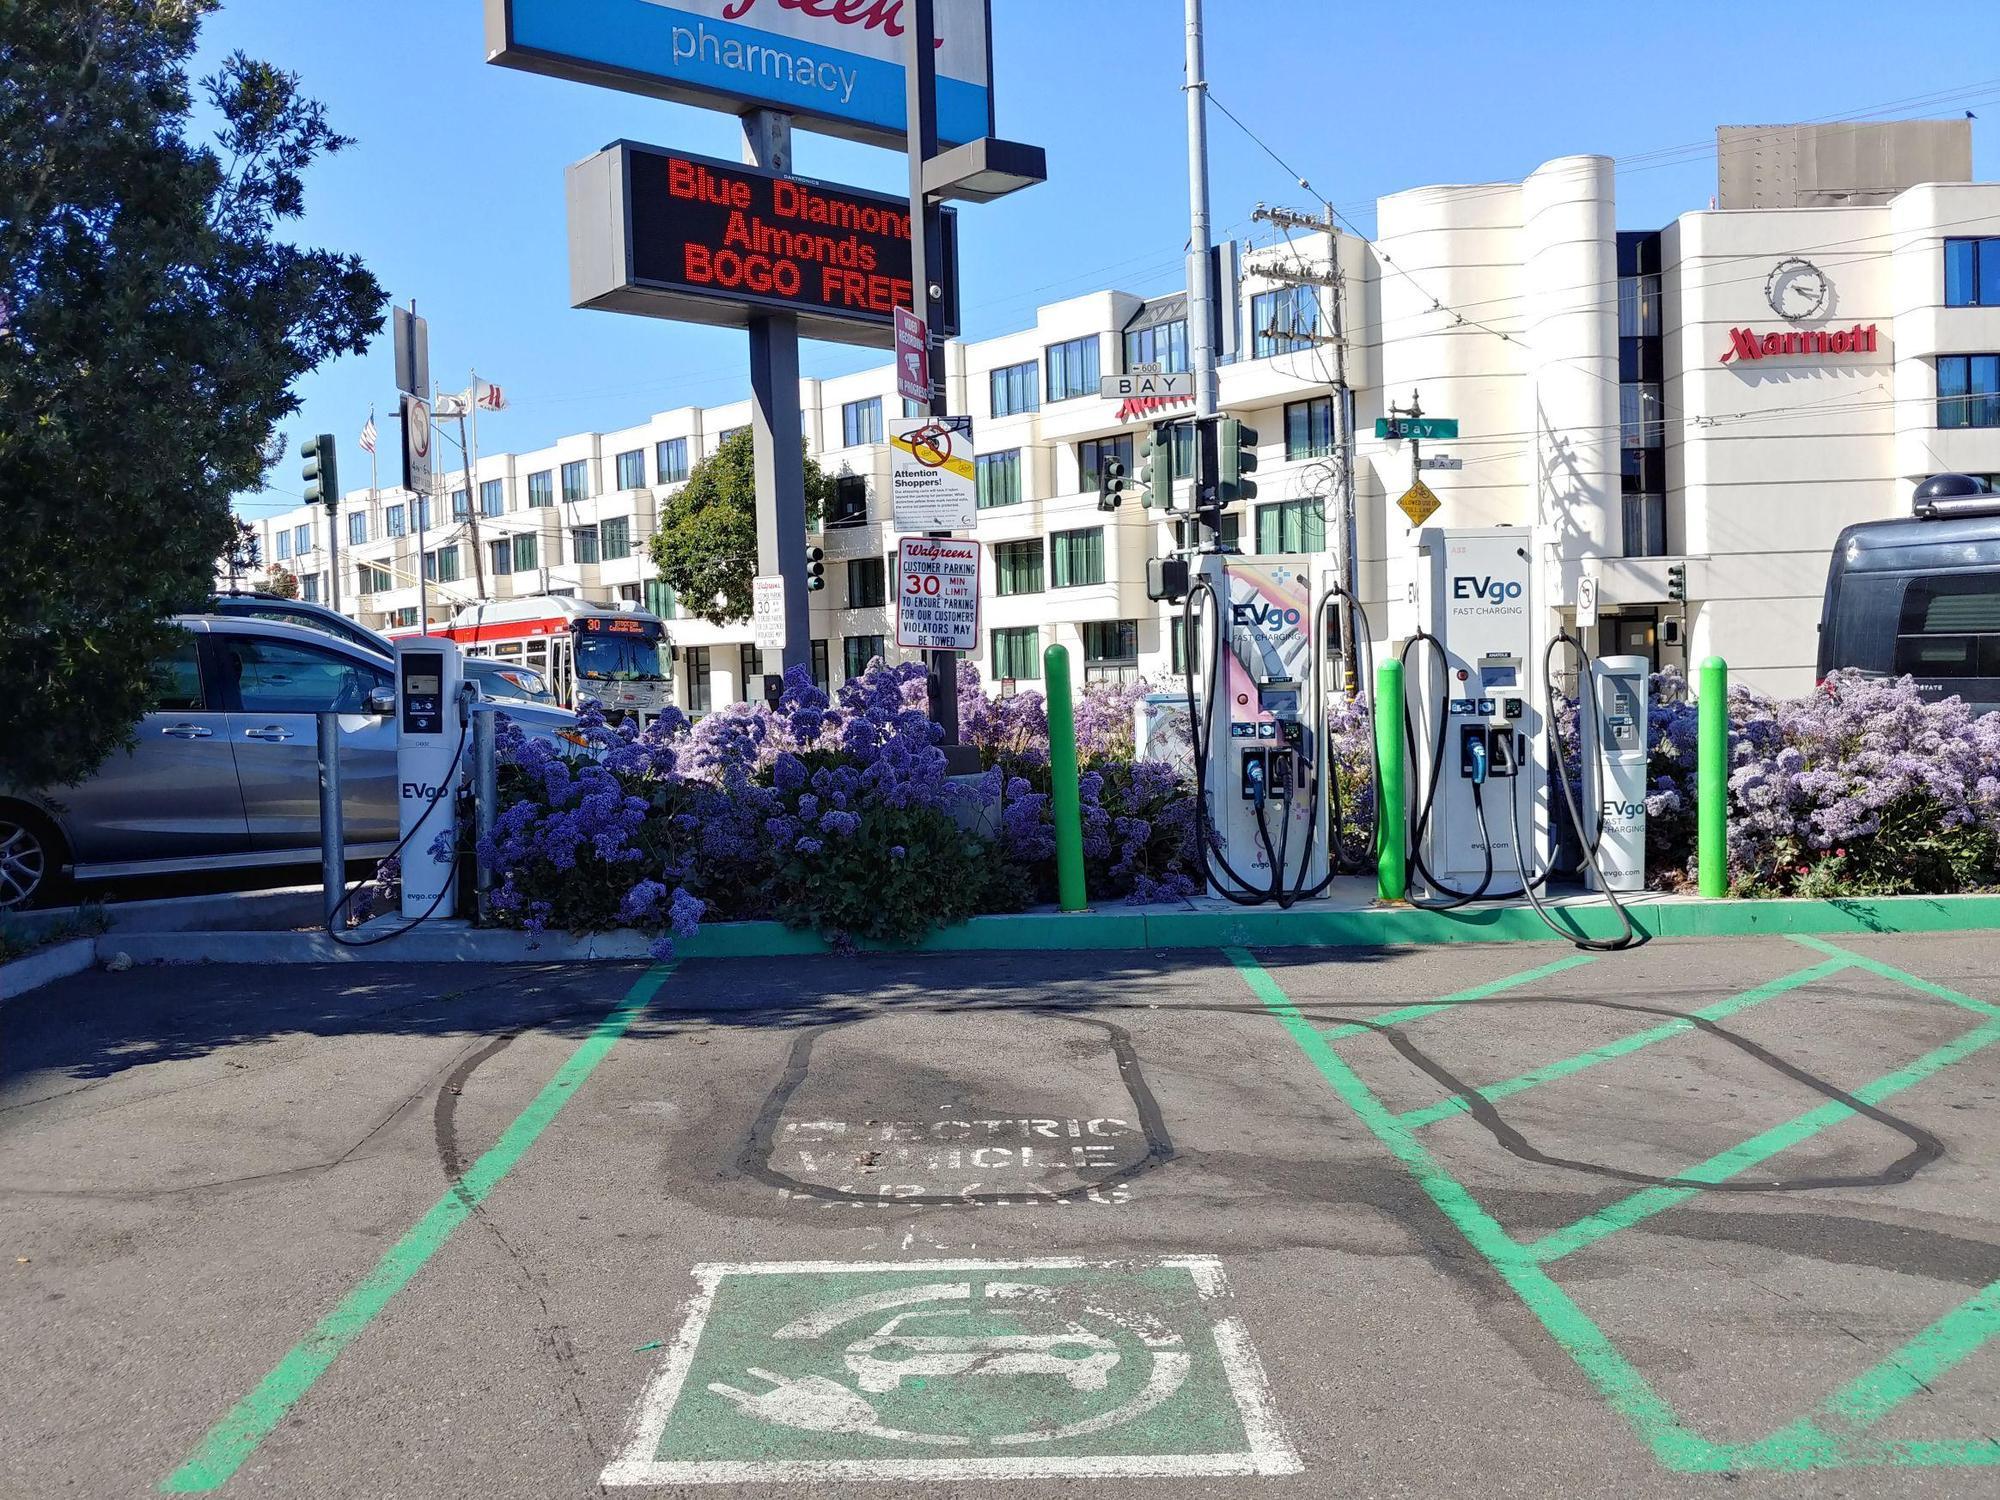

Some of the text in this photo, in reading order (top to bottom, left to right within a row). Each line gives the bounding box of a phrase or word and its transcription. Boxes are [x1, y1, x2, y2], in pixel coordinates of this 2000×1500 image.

[672, 23, 857, 104] pharmacy
[668, 157, 751, 208] Blue
[724, 209, 877, 271] Almonds
[684, 241, 912, 313] BOGO FREE
[1719, 323, 1878, 362] Marriott
[1119, 377, 1177, 394] BAY
[1400, 423, 1433, 436] Bay
[895, 470, 938, 478] Attention
[895, 478, 942, 488] Shoppers!
[906, 544, 973, 560] Walgreens
[903, 561, 975, 575] CUSTOMER PARKING
[905, 574, 965, 595] 30 MIN
[1454, 576, 1521, 605] EVgo
[945, 588, 968, 596] LIMIT
[757, 601, 770, 615] 30
[902, 596, 974, 610] TO ENSURE PARKING
[901, 609, 974, 622] FOR OUR CUSTOMERS
[1233, 603, 1300, 631] EVgo
[1476, 607, 1522, 615] CHARGING
[587, 619, 600, 631] 30
[903, 622, 971, 635] VIOLATORS MAY
[918, 636, 955, 647] BE TOWED
[402, 783, 449, 802] EVgo
[1603, 801, 1645, 819] EVgo
[1471, 842, 1509, 851] evg.com
[1604, 869, 1641, 878] evgo.com
